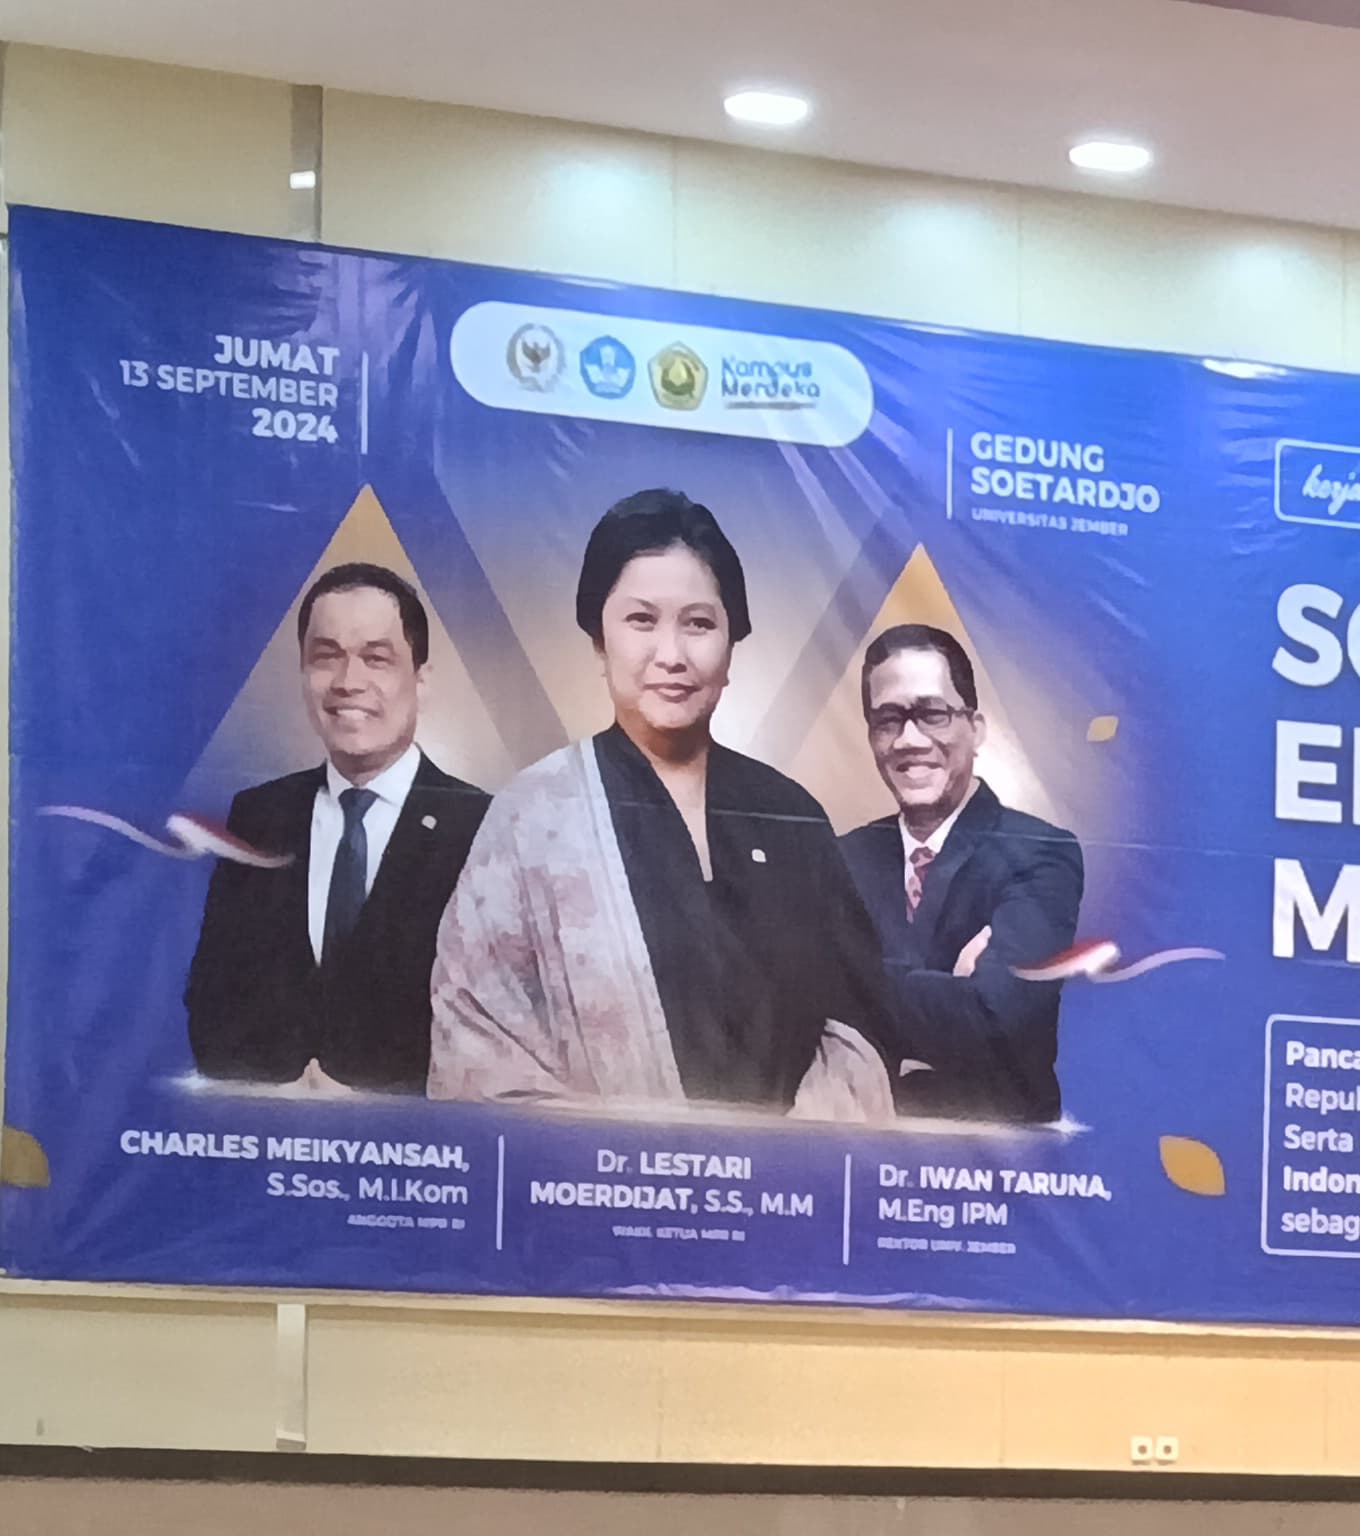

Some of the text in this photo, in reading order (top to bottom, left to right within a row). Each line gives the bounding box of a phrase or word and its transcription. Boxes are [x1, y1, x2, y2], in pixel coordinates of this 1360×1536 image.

[214, 334, 340, 375] JUMAT
[119, 359, 338, 408] 13 SEPTEMBER
[252, 407, 338, 444] 2024
[970, 431, 1104, 472] GEDUNG
[970, 466, 1160, 513] SOETARDJO
[120, 1129, 470, 1173] CHARLES MEIKYANSAH,
[1284, 1124, 1354, 1152] Serta
[639, 1151, 752, 1180] LESTARI
[920, 1165, 993, 1192] IWAN
[999, 1169, 1113, 1202] TARUNA,
[358, 1176, 468, 1205] M.I.Kom
[530, 1181, 698, 1214] MOERDIJAT,
[760, 1191, 814, 1217] M.M
[878, 1197, 1009, 1229] M.Eng IPM
